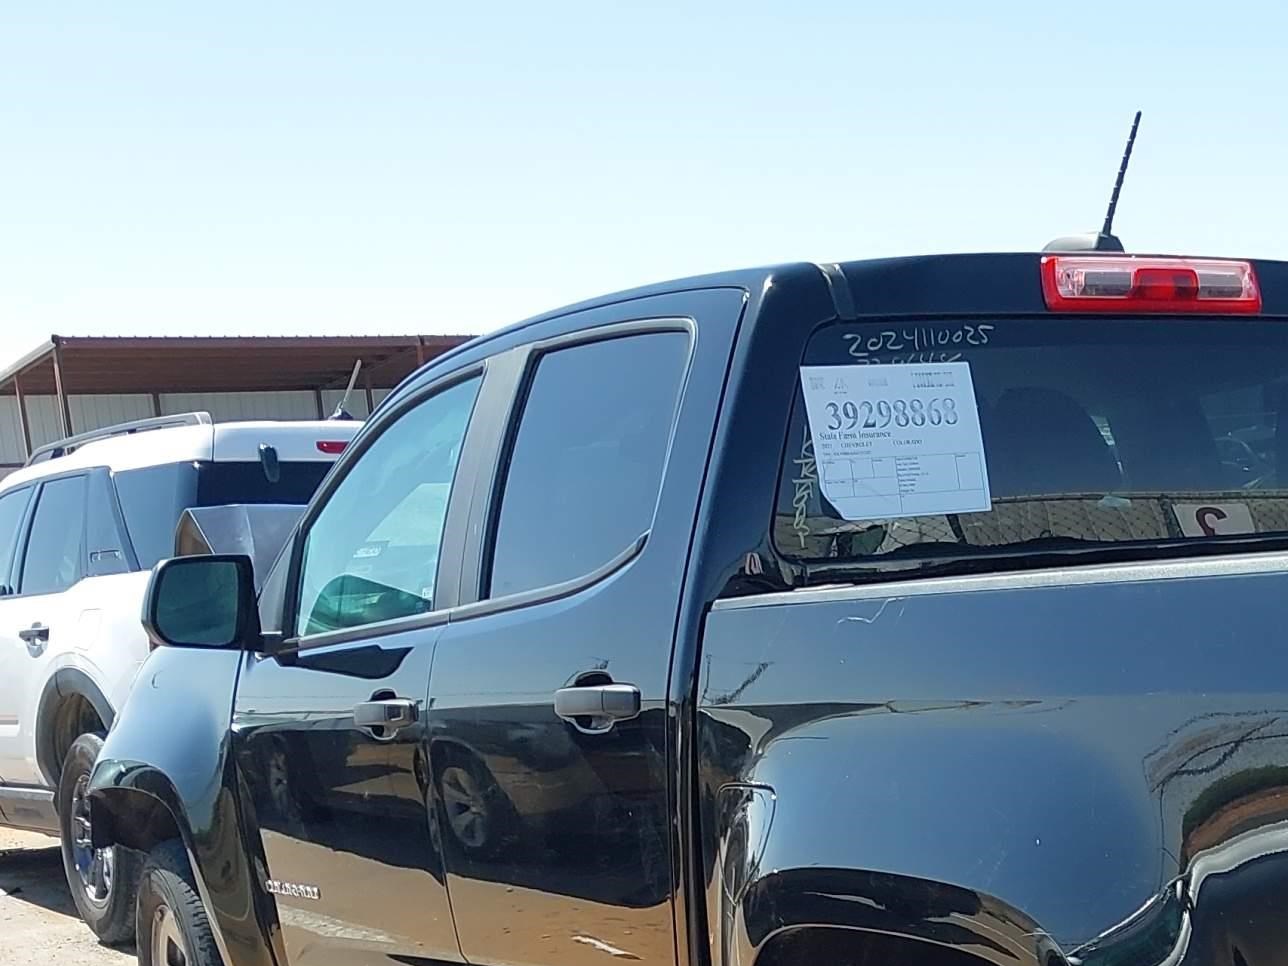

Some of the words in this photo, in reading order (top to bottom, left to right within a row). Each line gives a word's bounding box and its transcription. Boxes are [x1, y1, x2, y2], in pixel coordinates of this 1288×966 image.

[842, 324, 994, 357] 2024110025
[825, 397, 959, 430] 39298868
[858, 431, 891, 440] Insurance
